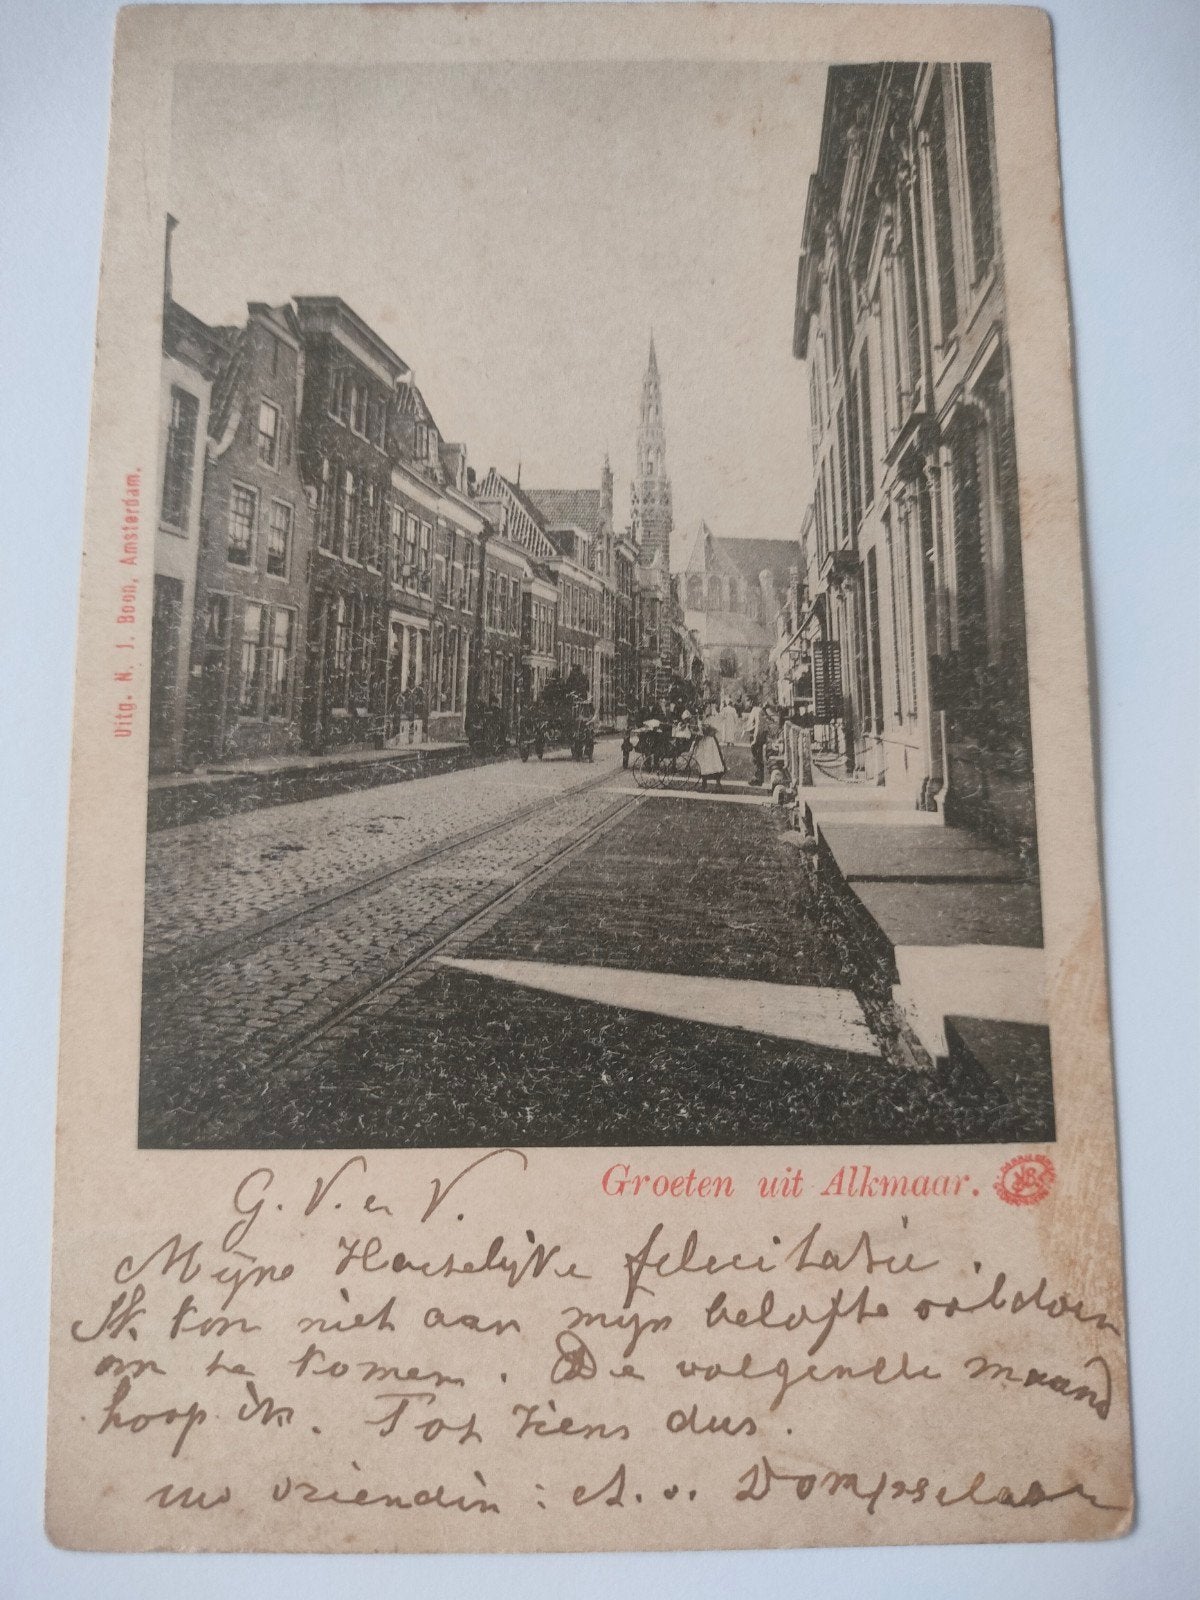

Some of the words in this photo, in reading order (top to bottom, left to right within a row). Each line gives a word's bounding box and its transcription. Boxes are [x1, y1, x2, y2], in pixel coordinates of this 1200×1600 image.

[118, 466, 142, 566] Amsterdam.
[117, 578, 139, 624] Boon,
[114, 665, 135, 682] N.
[601, 1163, 735, 1197] Groeten
[758, 1166, 804, 1199] uit
[821, 1165, 981, 1198] Alkmaar.
[423, 1307, 521, 1335] aan
